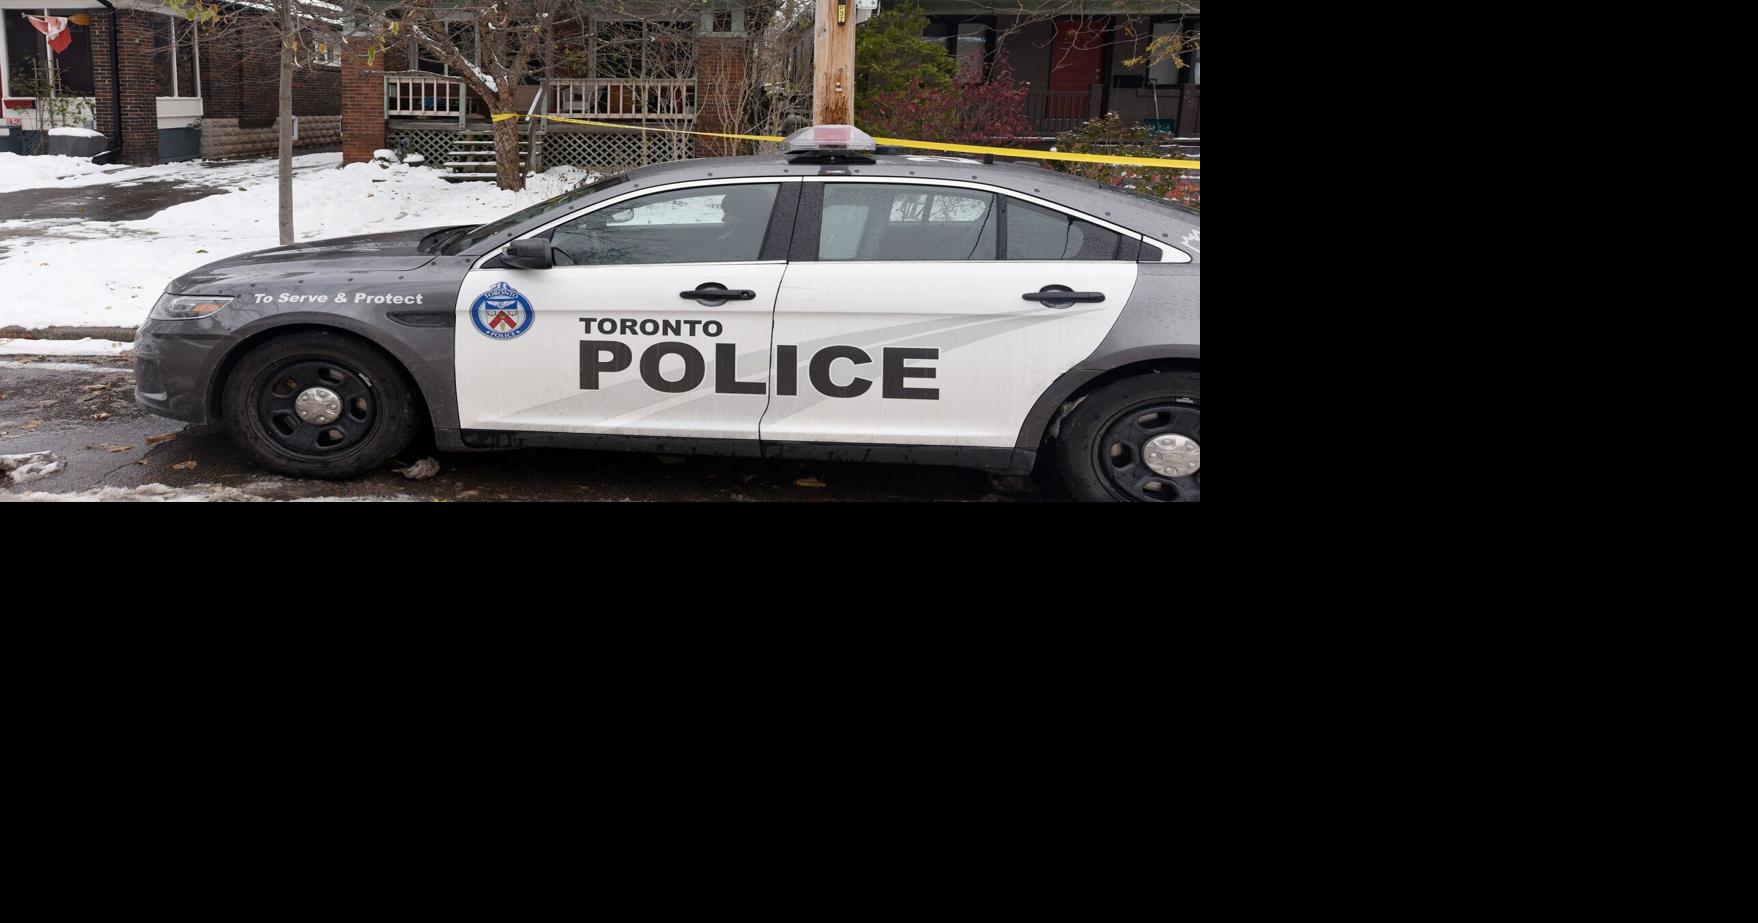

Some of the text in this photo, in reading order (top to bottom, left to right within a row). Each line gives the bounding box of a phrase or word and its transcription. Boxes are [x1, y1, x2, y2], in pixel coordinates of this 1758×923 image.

[254, 292, 423, 305] To Serve & Protect
[484, 290, 519, 300] TORONTO
[579, 317, 723, 337] TORONTO
[490, 331, 517, 339] POLICE
[579, 340, 940, 401] POLICE
